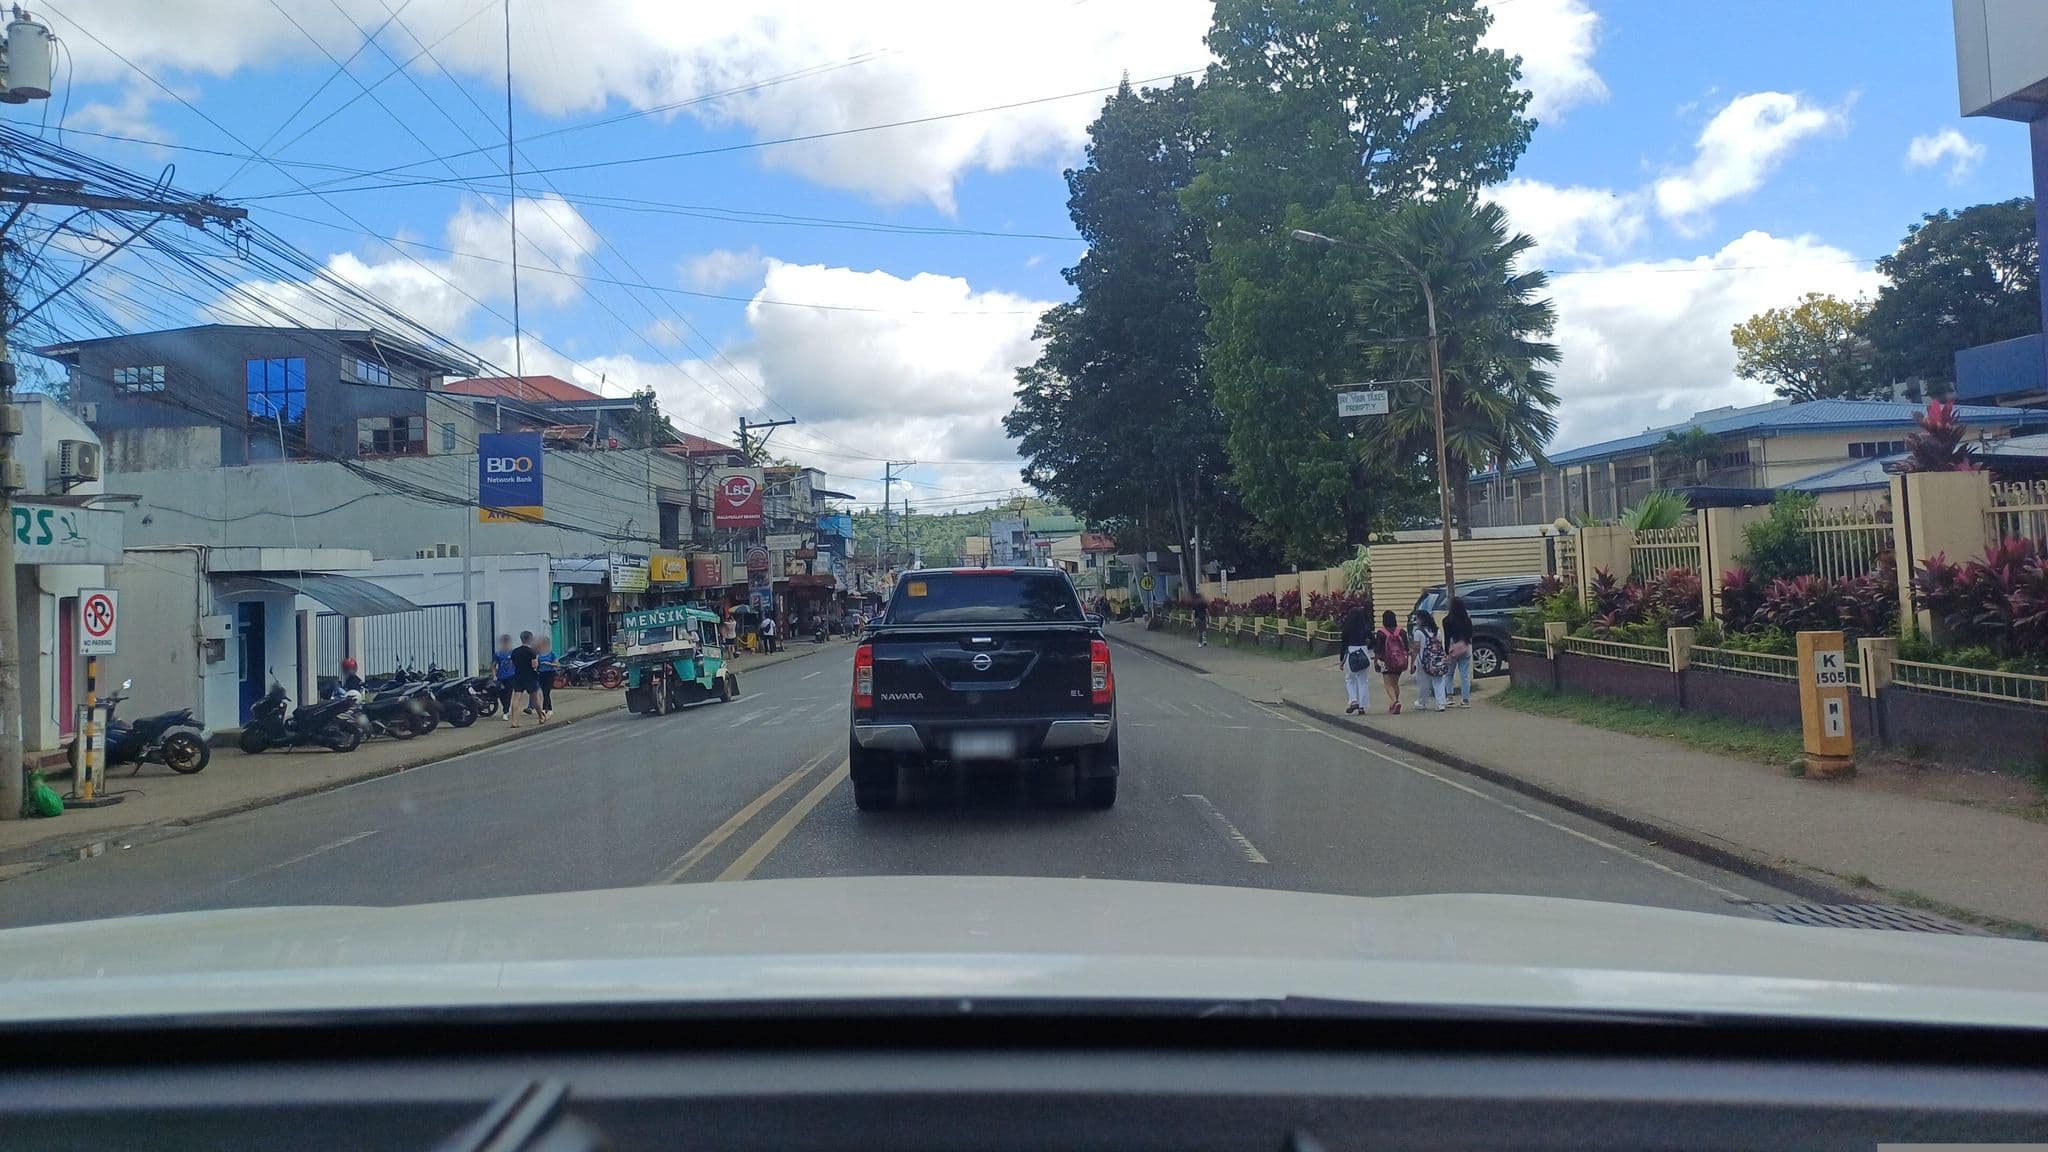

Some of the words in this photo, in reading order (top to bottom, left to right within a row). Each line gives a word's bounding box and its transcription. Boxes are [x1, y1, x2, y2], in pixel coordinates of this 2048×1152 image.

[487, 456, 533, 473] BDO
[83, 639, 91, 647] NO
[92, 639, 112, 647] PARKING
[1823, 654, 1836, 668] K
[1816, 671, 1846, 684] 1505
[880, 692, 924, 701] NAVARA
[1070, 689, 1084, 697] EL
